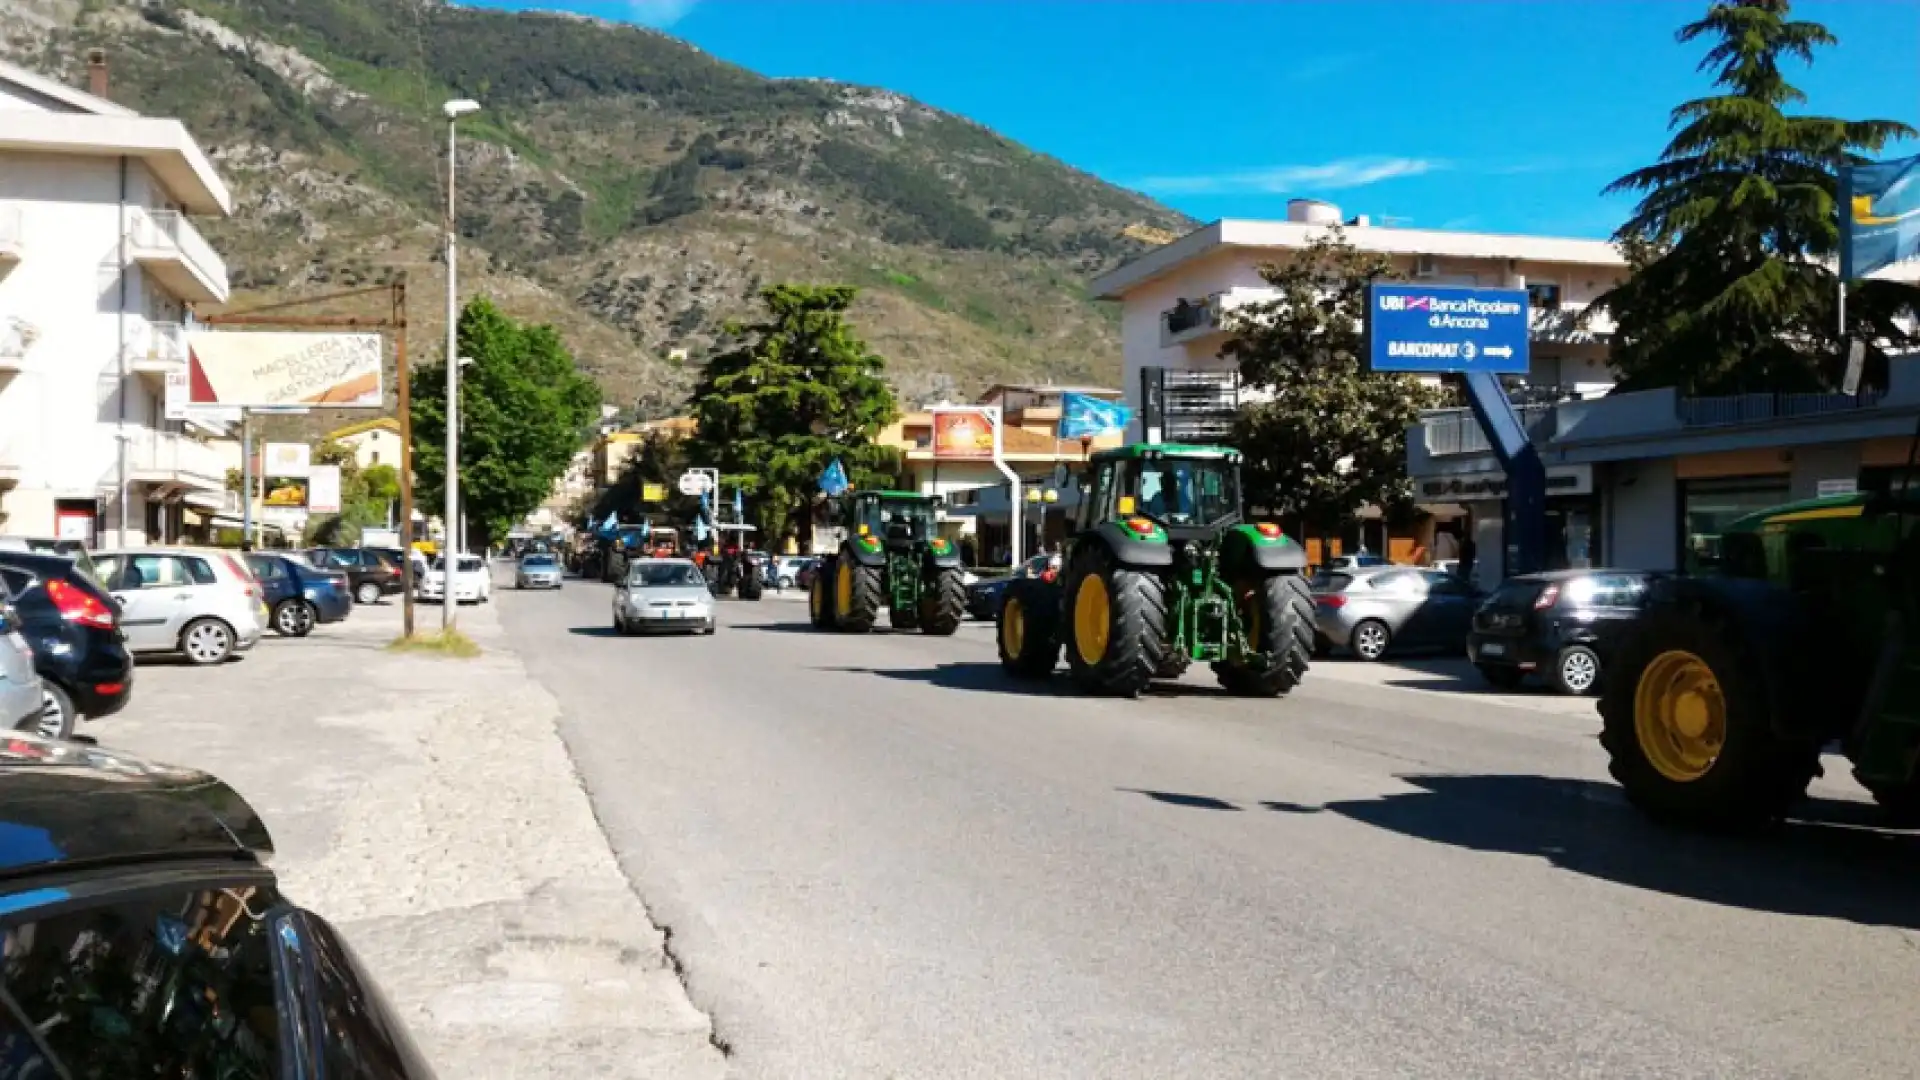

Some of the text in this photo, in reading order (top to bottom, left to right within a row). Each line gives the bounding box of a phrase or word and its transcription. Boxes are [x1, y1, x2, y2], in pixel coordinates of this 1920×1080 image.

[1380, 296, 1520, 314] UBI Banca Popolare
[1429, 313, 1489, 329] di Ancona
[1388, 340, 1458, 357] BANCOMAT
[253, 337, 340, 379] MACELLERIA
